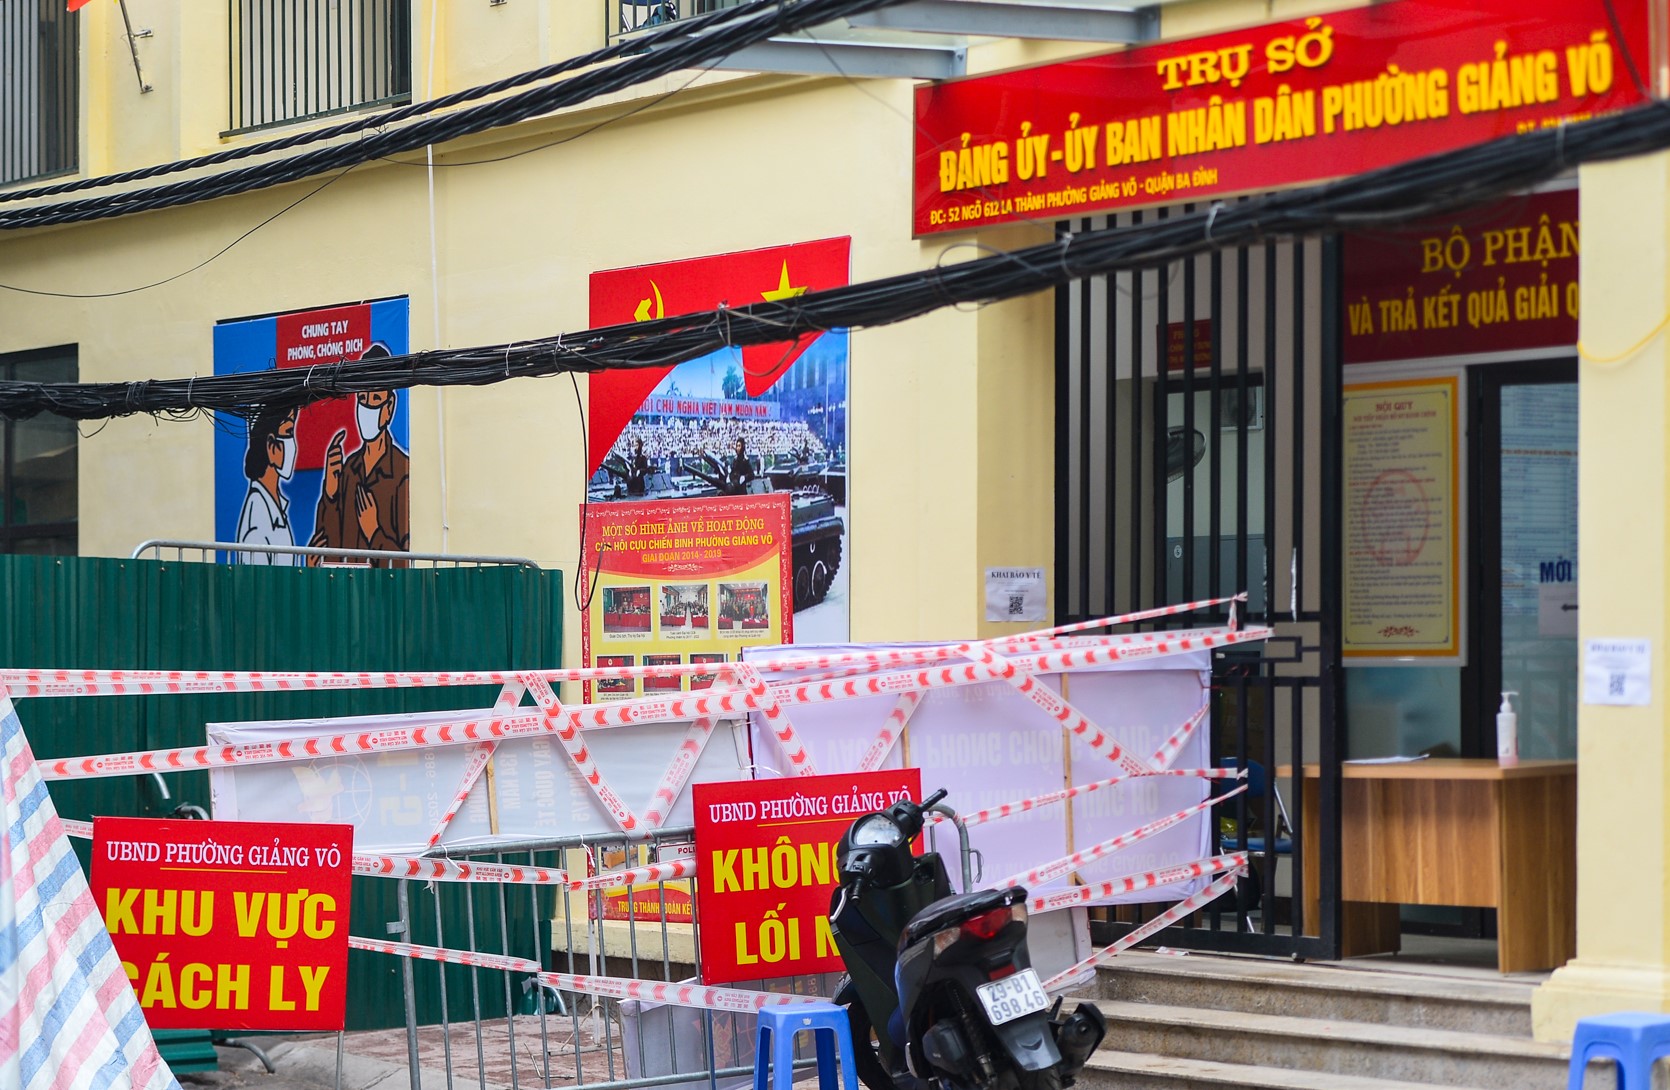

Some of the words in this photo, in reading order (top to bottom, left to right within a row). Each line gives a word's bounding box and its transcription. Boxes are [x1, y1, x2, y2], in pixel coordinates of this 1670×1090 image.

[1157, 42, 1254, 88] TRỤ
[1265, 15, 1335, 74] SỞ
[939, 132, 1009, 193] ĐẢNG
[1106, 115, 1162, 167] BAN
[1167, 95, 1246, 157] NHÂN
[1253, 83, 1315, 145] DÂN
[1322, 63, 1449, 134] PHƯỜNG
[1456, 39, 1559, 114] GIẢNG
[1565, 28, 1614, 97] VÕ
[930, 210, 947, 225] ĐC:
[948, 208, 960, 222] 52
[961, 199, 982, 221] NGÕ
[984, 201, 999, 218] 612
[1001, 200, 1013, 215] LA
[1014, 191, 1046, 213] THÀNH
[1047, 184, 1087, 208] PHƯỜNG
[1089, 177, 1120, 200] GIẢNG
[1121, 176, 1138, 197] VÕ
[1145, 170, 1175, 195] QUẬN
[1176, 172, 1191, 189] BA
[1192, 165, 1219, 186] ĐÌNH
[1420, 224, 1471, 279] BỘ
[1482, 212, 1579, 268] PHẬN
[1349, 295, 1375, 336] VÀ
[1378, 286, 1418, 333] TRẢ
[1423, 283, 1462, 330] KẾT
[1467, 275, 1510, 329] QUẢ
[1514, 271, 1559, 321] GIẢI
[301, 322, 329, 339] CHUNG
[330, 319, 349, 335] TAY
[287, 343, 316, 362] PHÒNG,
[316, 337, 344, 359] CHỐNG
[345, 337, 363, 357] DỊCH
[602, 522, 623, 537] MỘT
[625, 519, 638, 536] SỐ
[639, 521, 665, 536] HÌNH
[667, 517, 689, 534] ẢNH
[690, 515, 704, 533] VỀ
[705, 519, 734, 534] HOẠT
[735, 515, 765, 534] ĐỘNG
[613, 539, 628, 554] HỘI
[629, 538, 647, 554] CỰU
[648, 535, 673, 549] CHIẾN
[674, 537, 694, 549] BINH
[695, 534, 730, 547] PHƯỜNG
[731, 530, 759, 545] GIẢNG
[760, 532, 773, 544] VÕ
[642, 552, 658, 563] GIAI
[659, 551, 681, 564] ĐOẠN
[681, 549, 700, 561] 2014
[703, 548, 722, 560] 2019
[991, 571, 1009, 579] KHAI
[1010, 570, 1025, 579] BÁO
[708, 801, 757, 823] UBND
[760, 791, 828, 819] PHƯỜNG
[831, 785, 885, 814] GIẢNG
[106, 841, 161, 862] UBND
[165, 837, 244, 866] PHƯỜNG
[248, 837, 310, 867] GIẢNG
[314, 843, 342, 868] VÕ
[106, 887, 215, 937] KHU
[233, 888, 337, 949] VỰC
[617, 900, 639, 913] TRUG
[639, 899, 660, 914] THÀNH
[735, 903, 801, 965] LỐI
[121, 952, 251, 1011] ÁCH
[269, 965, 331, 1012] LY
[987, 975, 1031, 1003] 29-B1
[990, 990, 1045, 1021] 698.46
